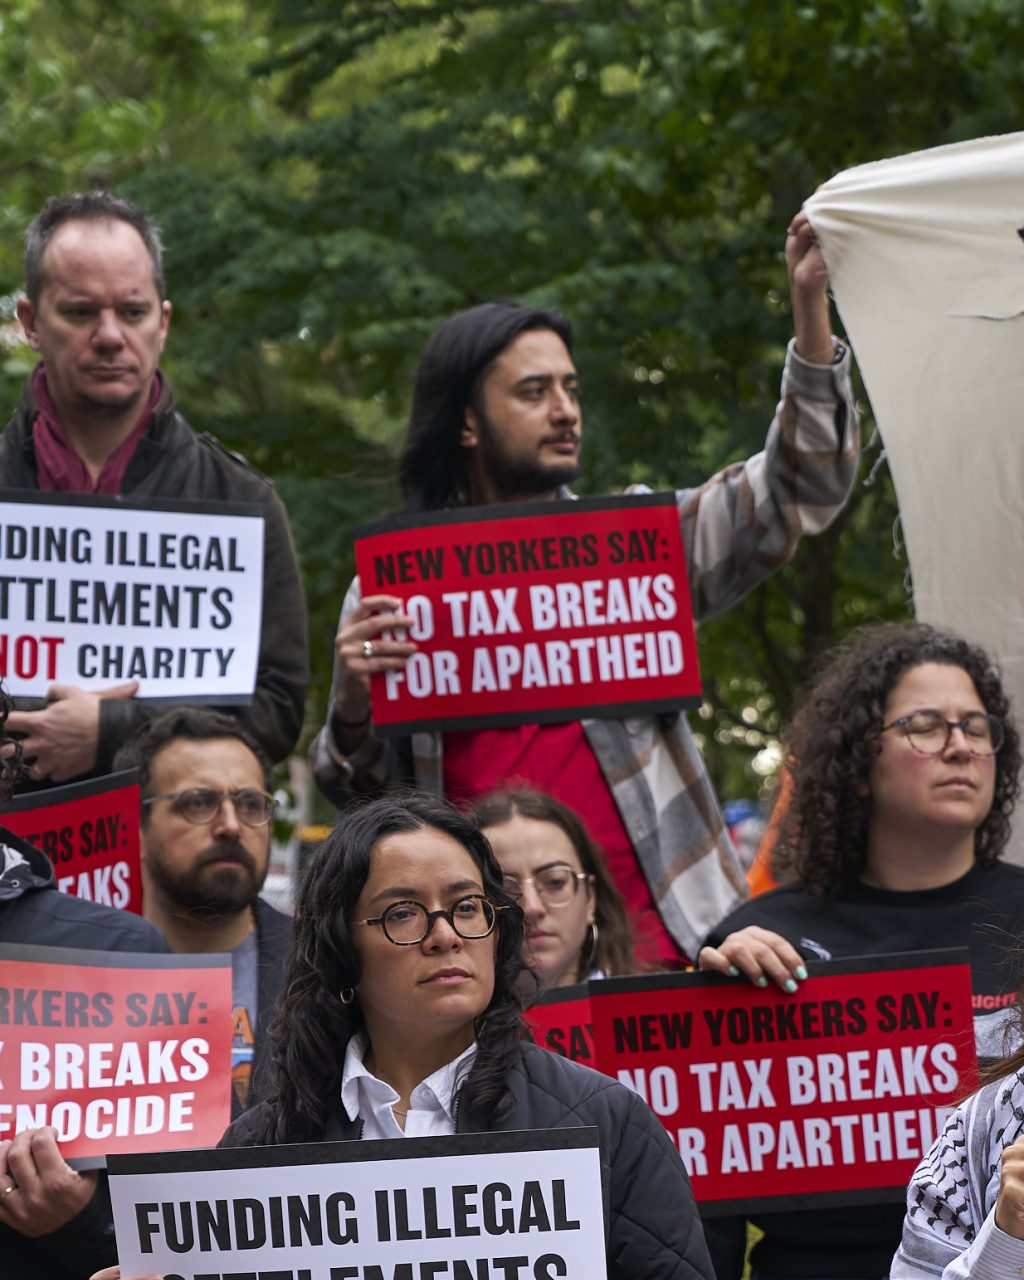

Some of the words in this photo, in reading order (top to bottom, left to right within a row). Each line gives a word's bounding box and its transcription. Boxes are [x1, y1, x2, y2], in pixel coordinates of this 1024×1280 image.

[0, 525, 92, 564] DING
[105, 530, 245, 572] ILLEGAL
[374, 547, 444, 588] NEW
[453, 533, 598, 577] YORKERS
[607, 528, 670, 565] SAY:
[442, 587, 522, 638] TAX
[529, 573, 677, 631] BREAKS
[78, 643, 235, 679] CHARITY
[471, 630, 685, 693] APARTHEID
[80, 813, 128, 857] SAY:
[125, 991, 208, 1027] SAY:
[613, 1011, 693, 1054] NEW
[703, 997, 867, 1044] YORKERS
[877, 990, 954, 1034] SAY:
[20, 1037, 210, 1091] BREAKS
[690, 1058, 777, 1113] TAX
[786, 1043, 958, 1103] BREAKS
[134, 1191, 359, 1254] FUNDING
[374, 1178, 581, 1243] ILLEGAL
